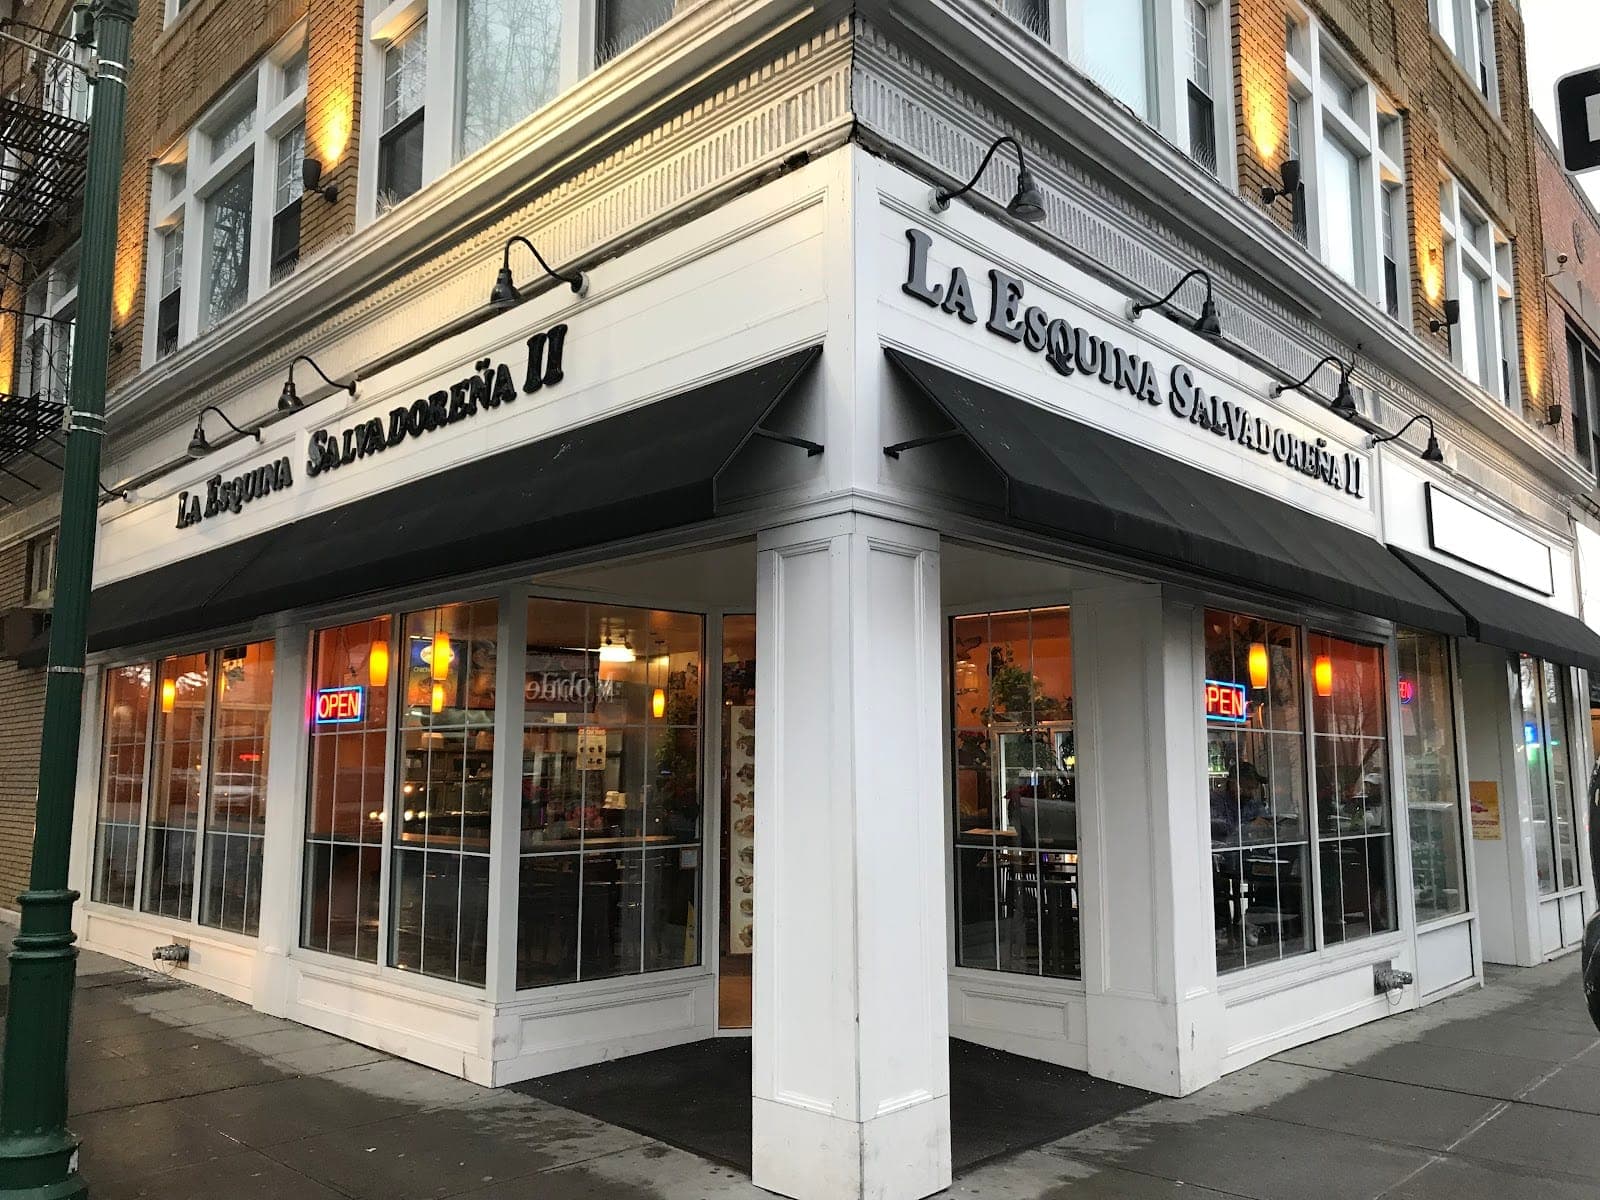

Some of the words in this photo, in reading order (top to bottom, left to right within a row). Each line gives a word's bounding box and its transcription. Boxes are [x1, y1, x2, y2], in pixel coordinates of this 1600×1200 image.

[902, 228, 977, 324] LA
[985, 268, 1163, 406] ESQUINA
[1169, 363, 1344, 490] SALVADOREÑA
[1345, 453, 1366, 499] II
[176, 491, 202, 529] LA
[204, 456, 293, 518] ESQUINA
[306, 358, 518, 477] SALVADOREÑA
[523, 323, 569, 394] II
[319, 692, 359, 719] OPEN
[1205, 686, 1243, 716] PEN
